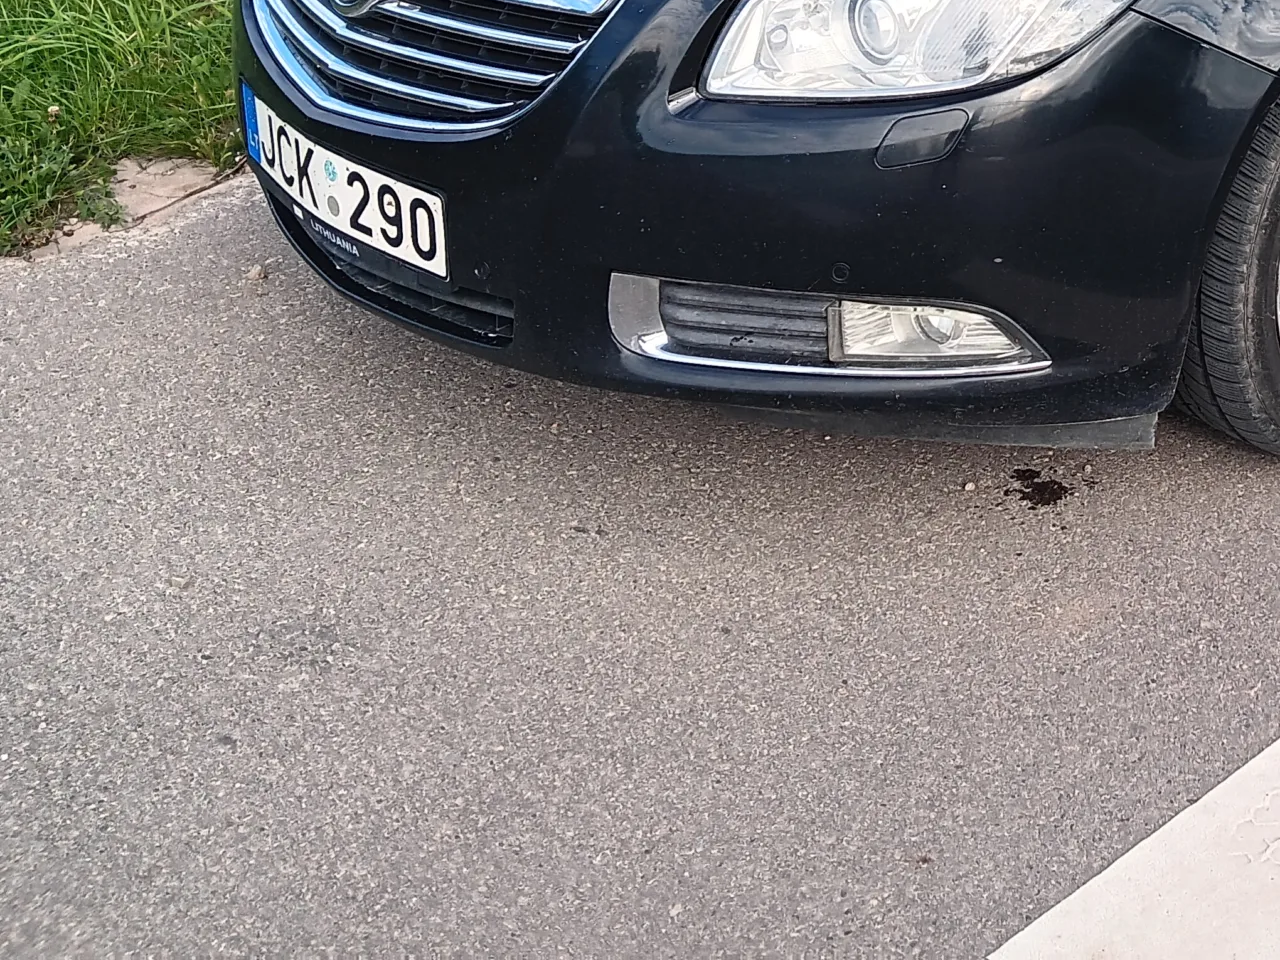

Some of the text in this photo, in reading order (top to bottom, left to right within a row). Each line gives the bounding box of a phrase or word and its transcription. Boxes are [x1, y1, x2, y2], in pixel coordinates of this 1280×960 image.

[248, 128, 259, 150] LT
[260, 115, 437, 262] JCK 290
[310, 219, 360, 257] LITHUANIA
